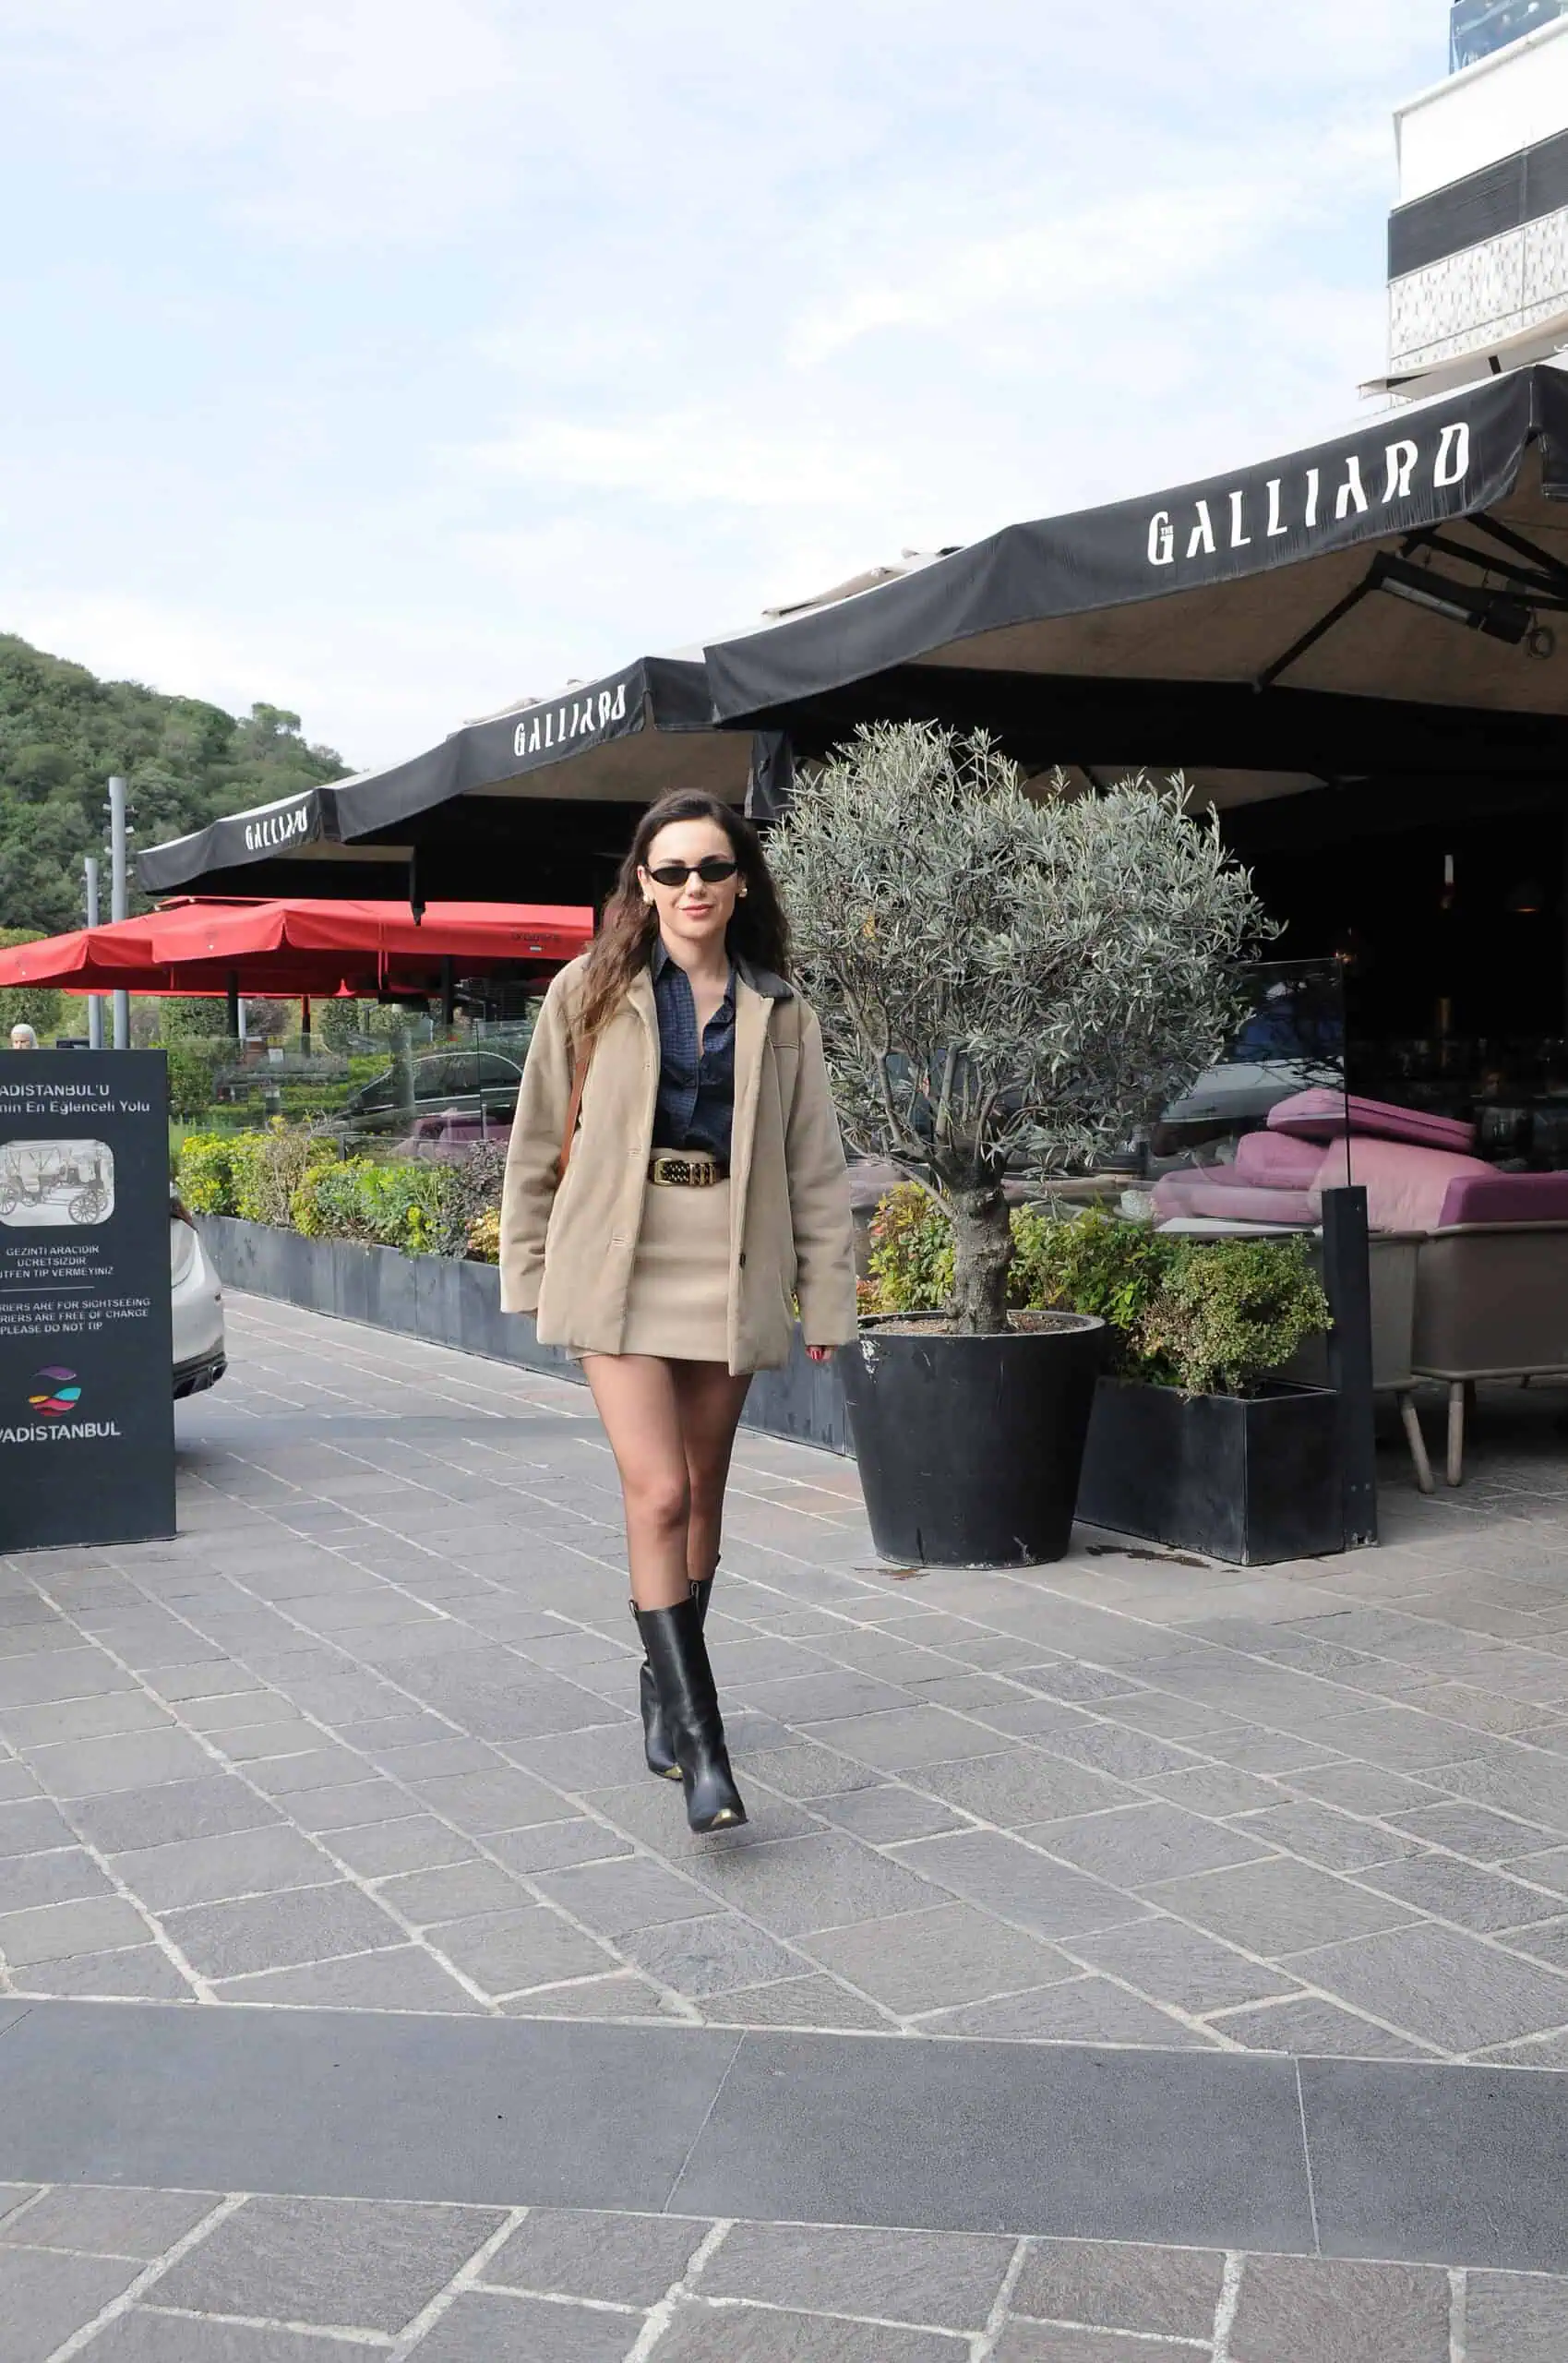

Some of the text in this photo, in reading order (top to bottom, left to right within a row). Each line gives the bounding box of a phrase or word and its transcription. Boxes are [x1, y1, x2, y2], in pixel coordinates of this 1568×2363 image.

[1147, 422, 1469, 566] GALLIARD
[513, 683, 626, 757] GALLIARD
[0, 1084, 110, 1097] ADISTANBUL'U
[0, 1101, 22, 1113] nin
[26, 1100, 45, 1112] En
[119, 1099, 150, 1112] Yolu
[33, 1301, 54, 1311] ARE
[57, 1300, 79, 1310] FOR
[82, 1298, 151, 1309] SIGHTSEEING
[34, 1312, 55, 1322] ARE
[59, 1311, 85, 1321] FREE
[89, 1310, 102, 1320] OF
[106, 1308, 149, 1318] CHARGE
[0, 1321, 103, 1336] PLEASE DO NOT TIP
